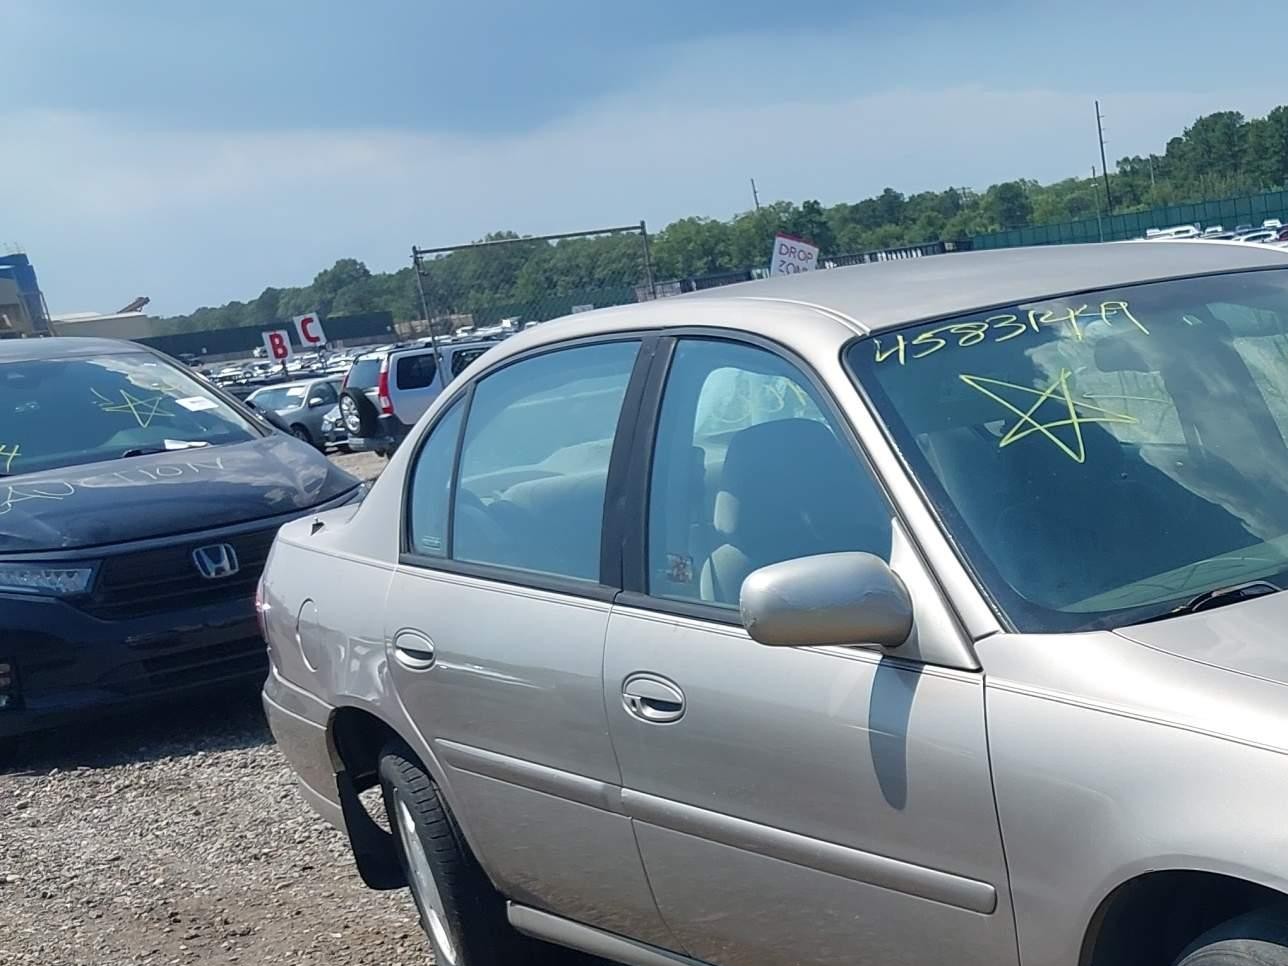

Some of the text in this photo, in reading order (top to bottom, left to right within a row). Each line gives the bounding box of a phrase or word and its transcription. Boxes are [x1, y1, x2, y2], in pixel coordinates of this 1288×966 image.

[778, 243, 813, 263] DROP
[300, 317, 320, 343] C
[269, 333, 288, 359] B
